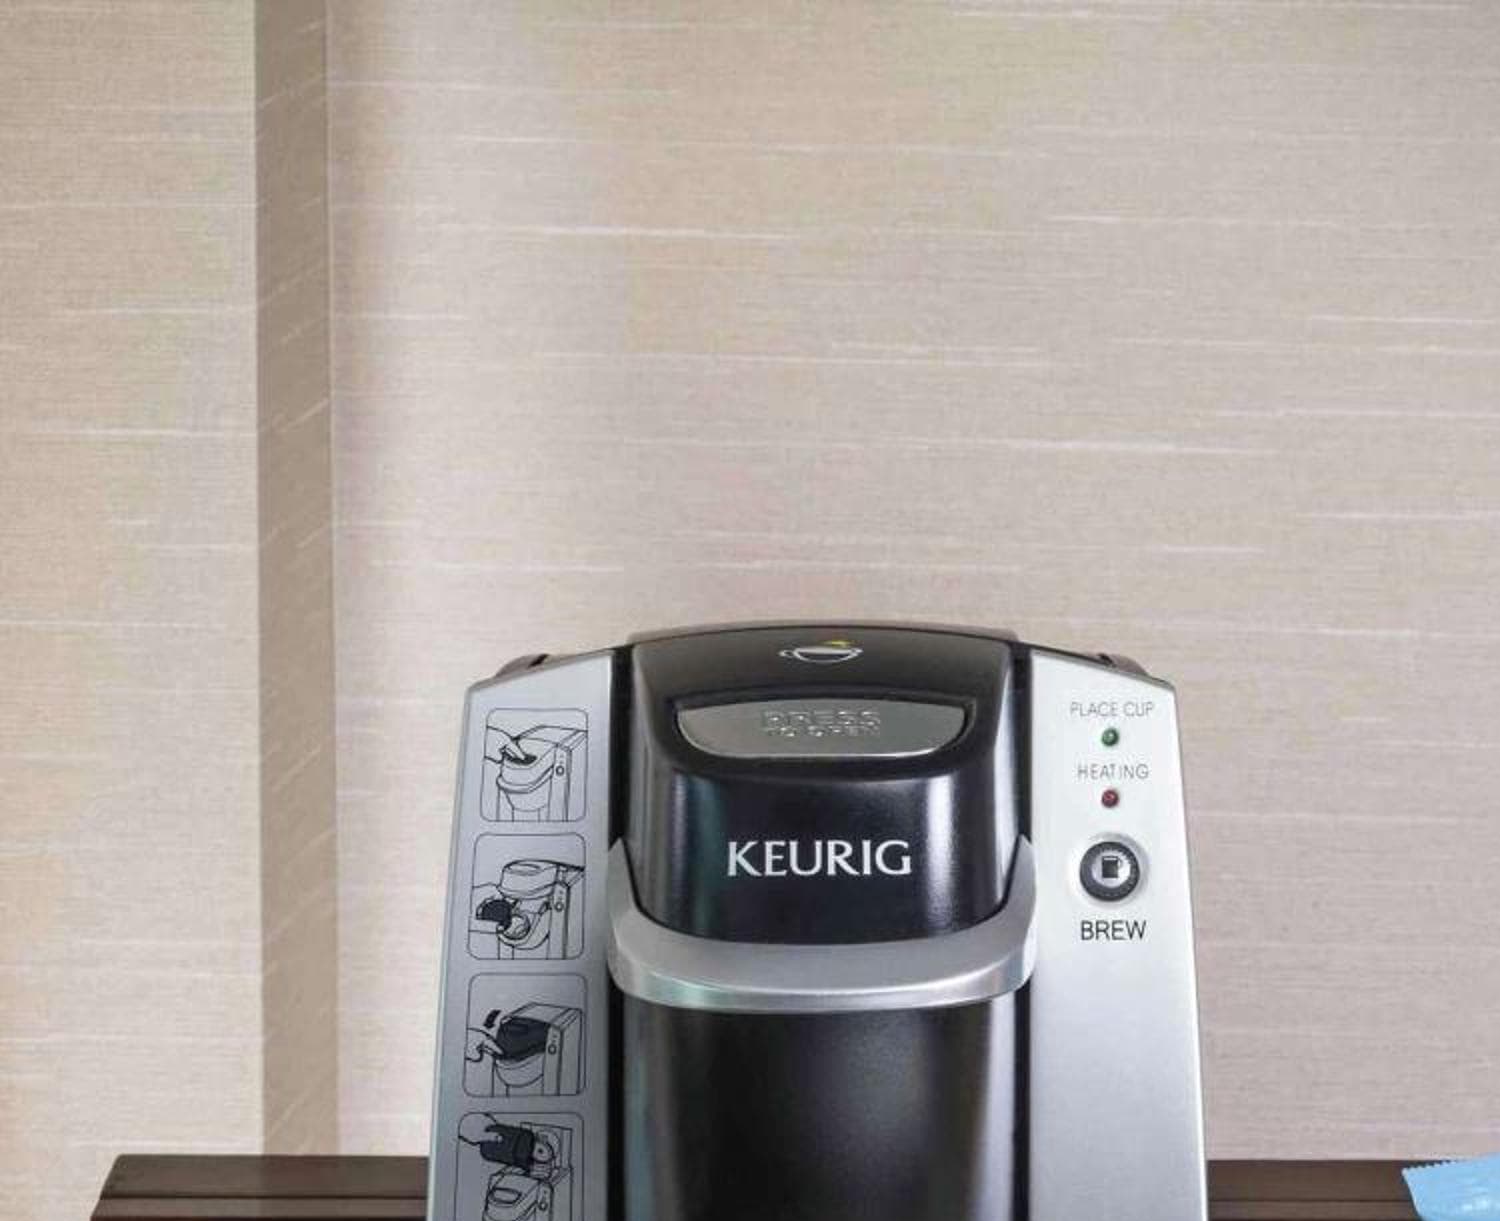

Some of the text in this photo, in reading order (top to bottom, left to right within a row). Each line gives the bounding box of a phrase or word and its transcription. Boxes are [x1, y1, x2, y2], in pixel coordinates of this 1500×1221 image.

[1070, 701, 1154, 717] PLACE CUP
[1077, 763, 1149, 780] HEATING
[727, 839, 912, 877] KEURIG
[1080, 919, 1147, 941] BREW
